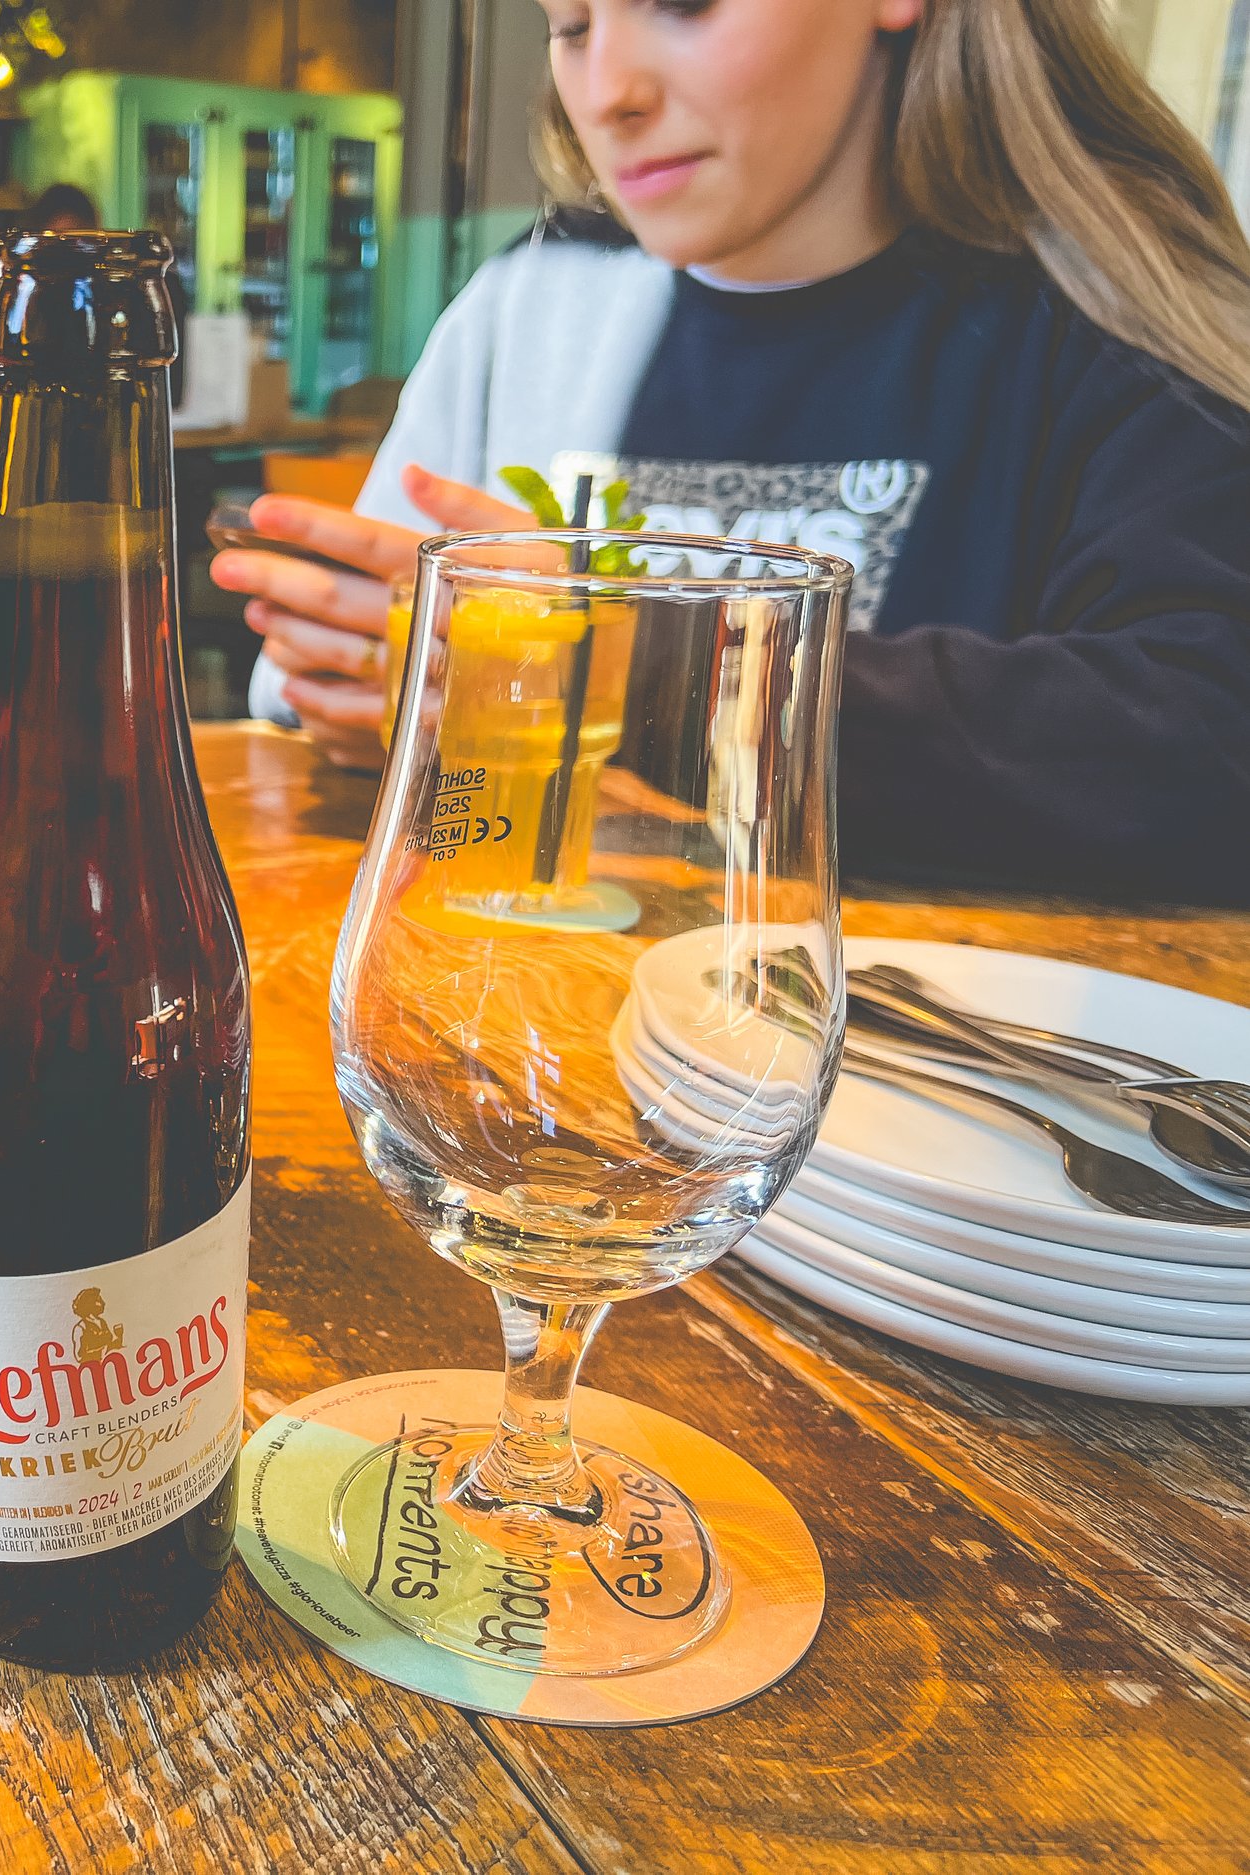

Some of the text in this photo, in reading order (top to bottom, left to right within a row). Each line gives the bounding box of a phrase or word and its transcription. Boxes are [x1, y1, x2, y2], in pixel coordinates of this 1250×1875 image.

[35, 1394, 178, 1446] CRAFT BLENDERS
[97, 1397, 202, 1480] Brut
[2, 1521, 83, 1540] GEAROMATISEERD
[92, 1514, 120, 1531] BIERE
[121, 1495, 162, 1523] MACÉRÉE
[162, 1484, 183, 1505] AVEC
[183, 1472, 198, 1493] DES
[32, 1505, 64, 1519] BLENDED
[78, 1488, 120, 1516] 2024
[132, 1482, 143, 1500] 2
[40, 1529, 107, 1551] AROMATISIERT
[116, 1519, 140, 1538] BEER
[141, 1508, 163, 1528] AGED
[163, 1496, 184, 1518] WITH
[615, 1471, 677, 1599] share
[252, 1516, 293, 1583] #heavenlypizza
[287, 1579, 362, 1640] #gloriousbeer
